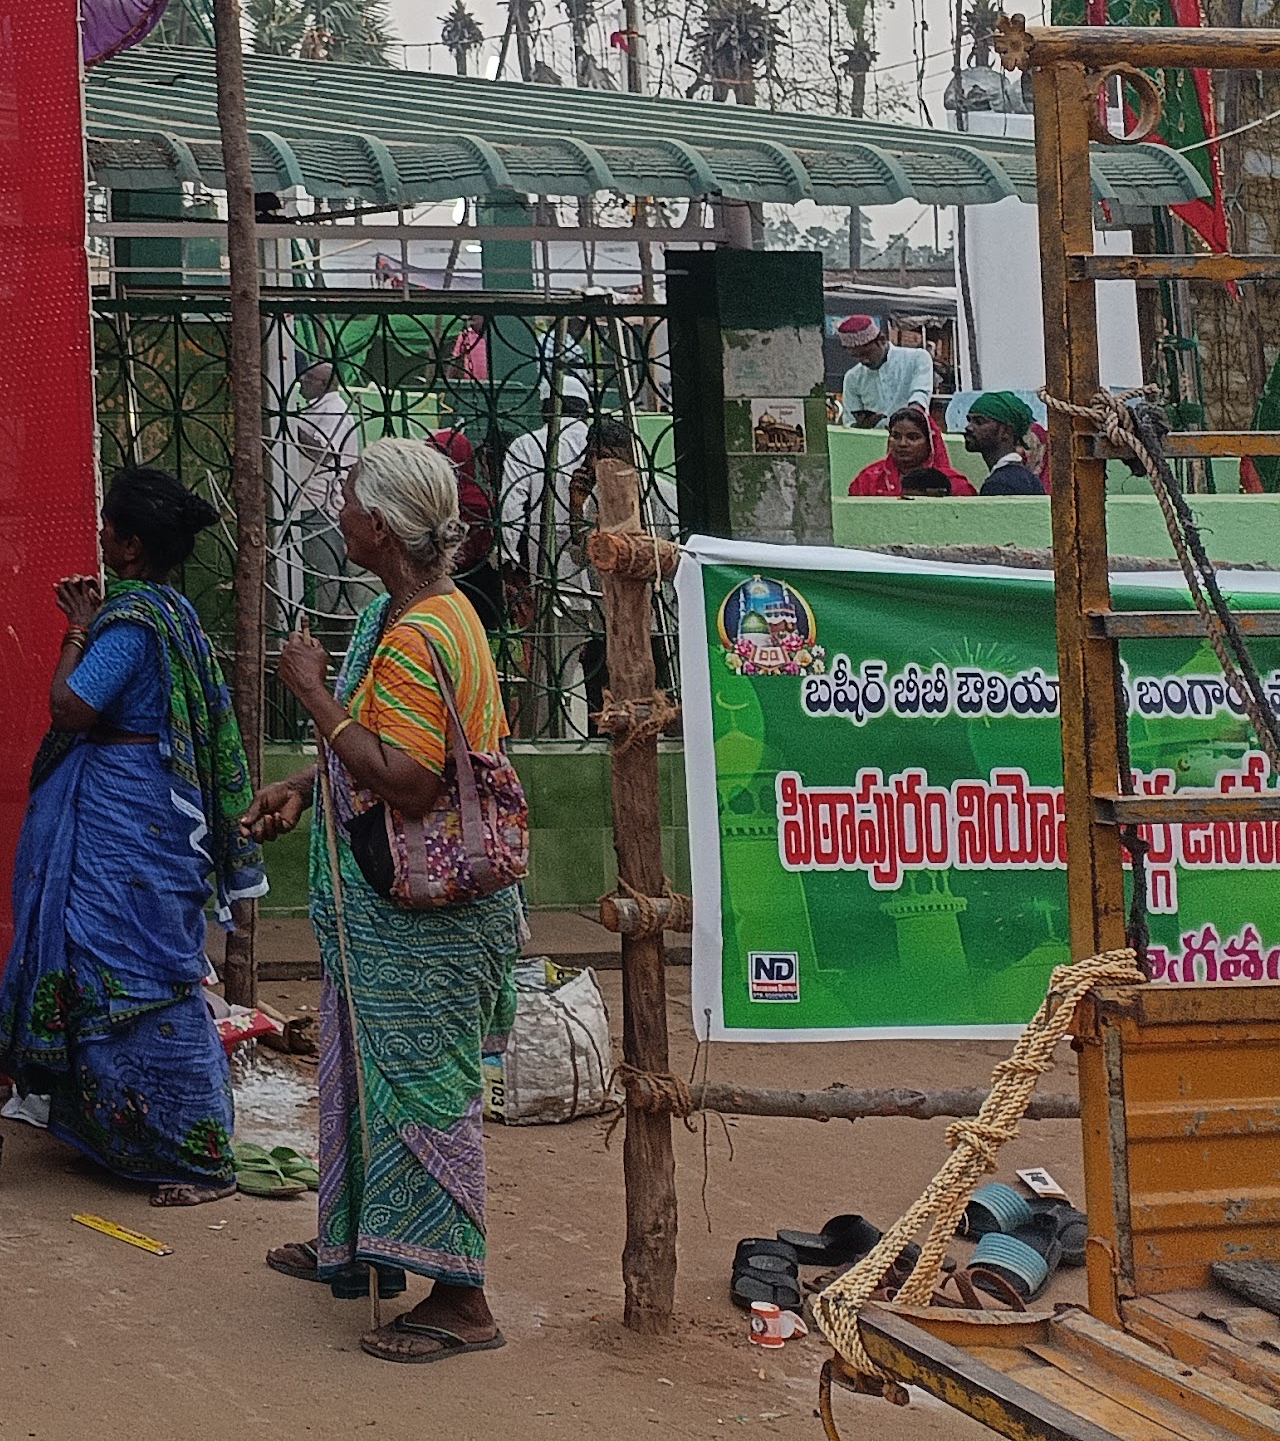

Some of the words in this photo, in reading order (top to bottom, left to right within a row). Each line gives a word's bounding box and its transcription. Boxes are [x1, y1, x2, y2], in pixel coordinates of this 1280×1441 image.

[804, 658, 886, 722] బషీర్
[894, 666, 948, 714] బీబీ
[780, 773, 949, 885] పిఠాపురం
[754, 957, 794, 981] ND
[491, 1078, 505, 1107] 103
